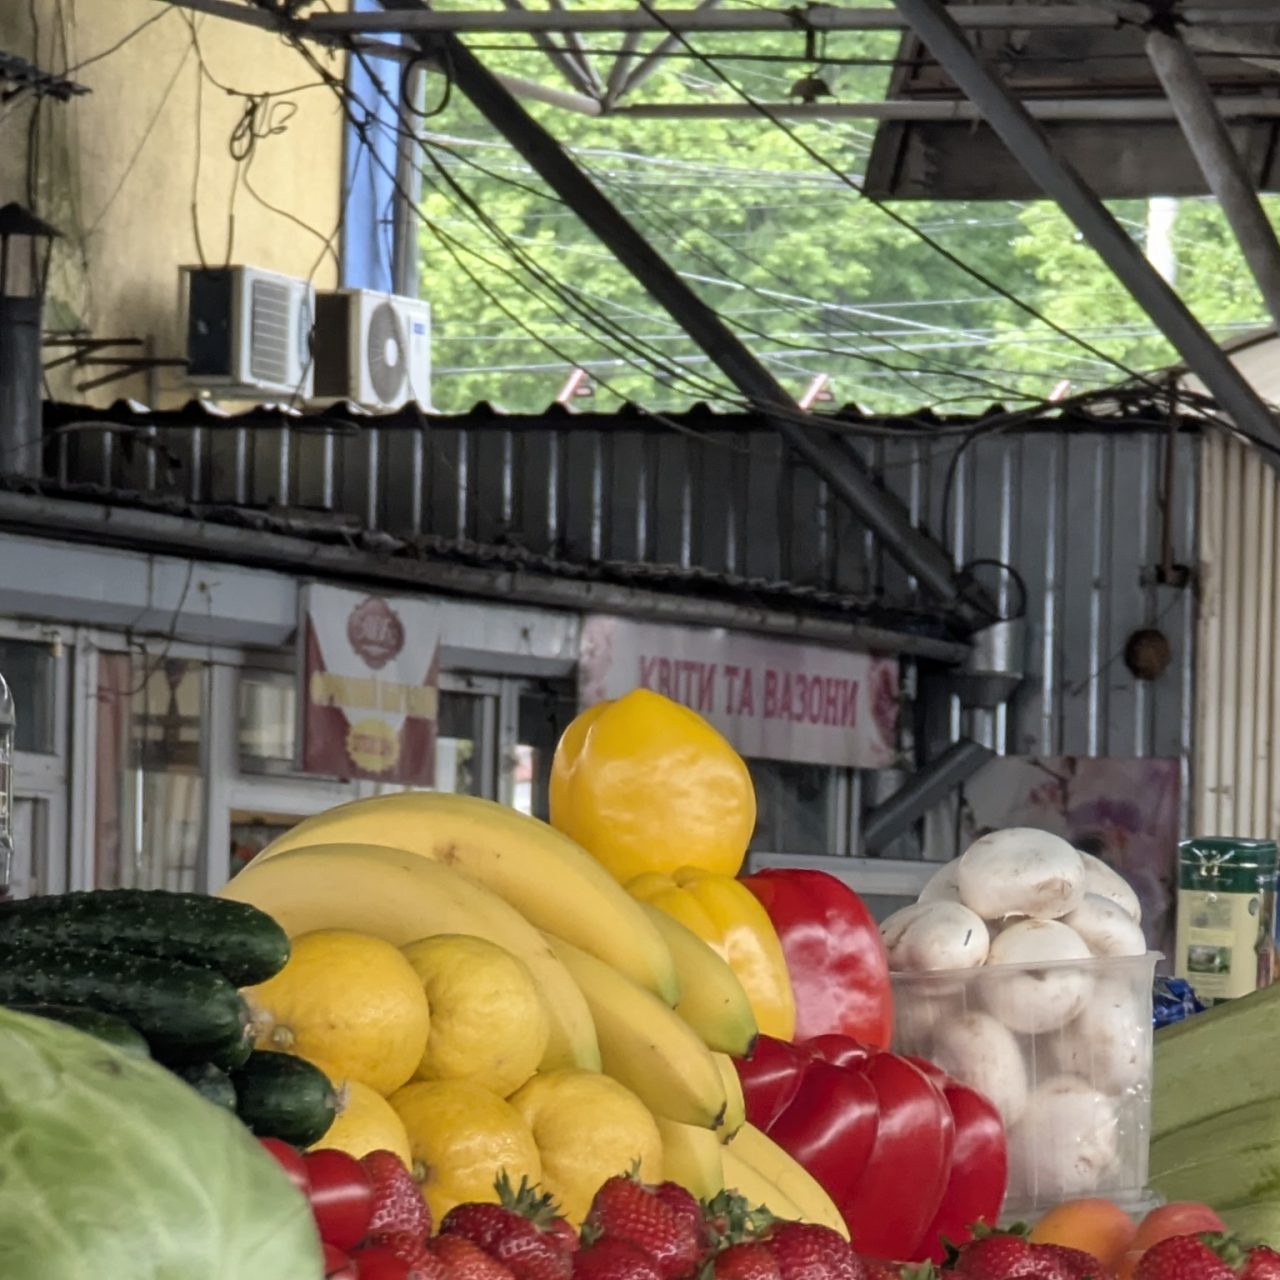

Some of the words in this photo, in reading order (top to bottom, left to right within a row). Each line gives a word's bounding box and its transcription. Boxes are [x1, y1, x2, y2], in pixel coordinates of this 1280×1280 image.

[640, 656, 716, 713] КВІТИ
[724, 664, 755, 716] ТА
[764, 668, 859, 728] ВАЗОНИ
